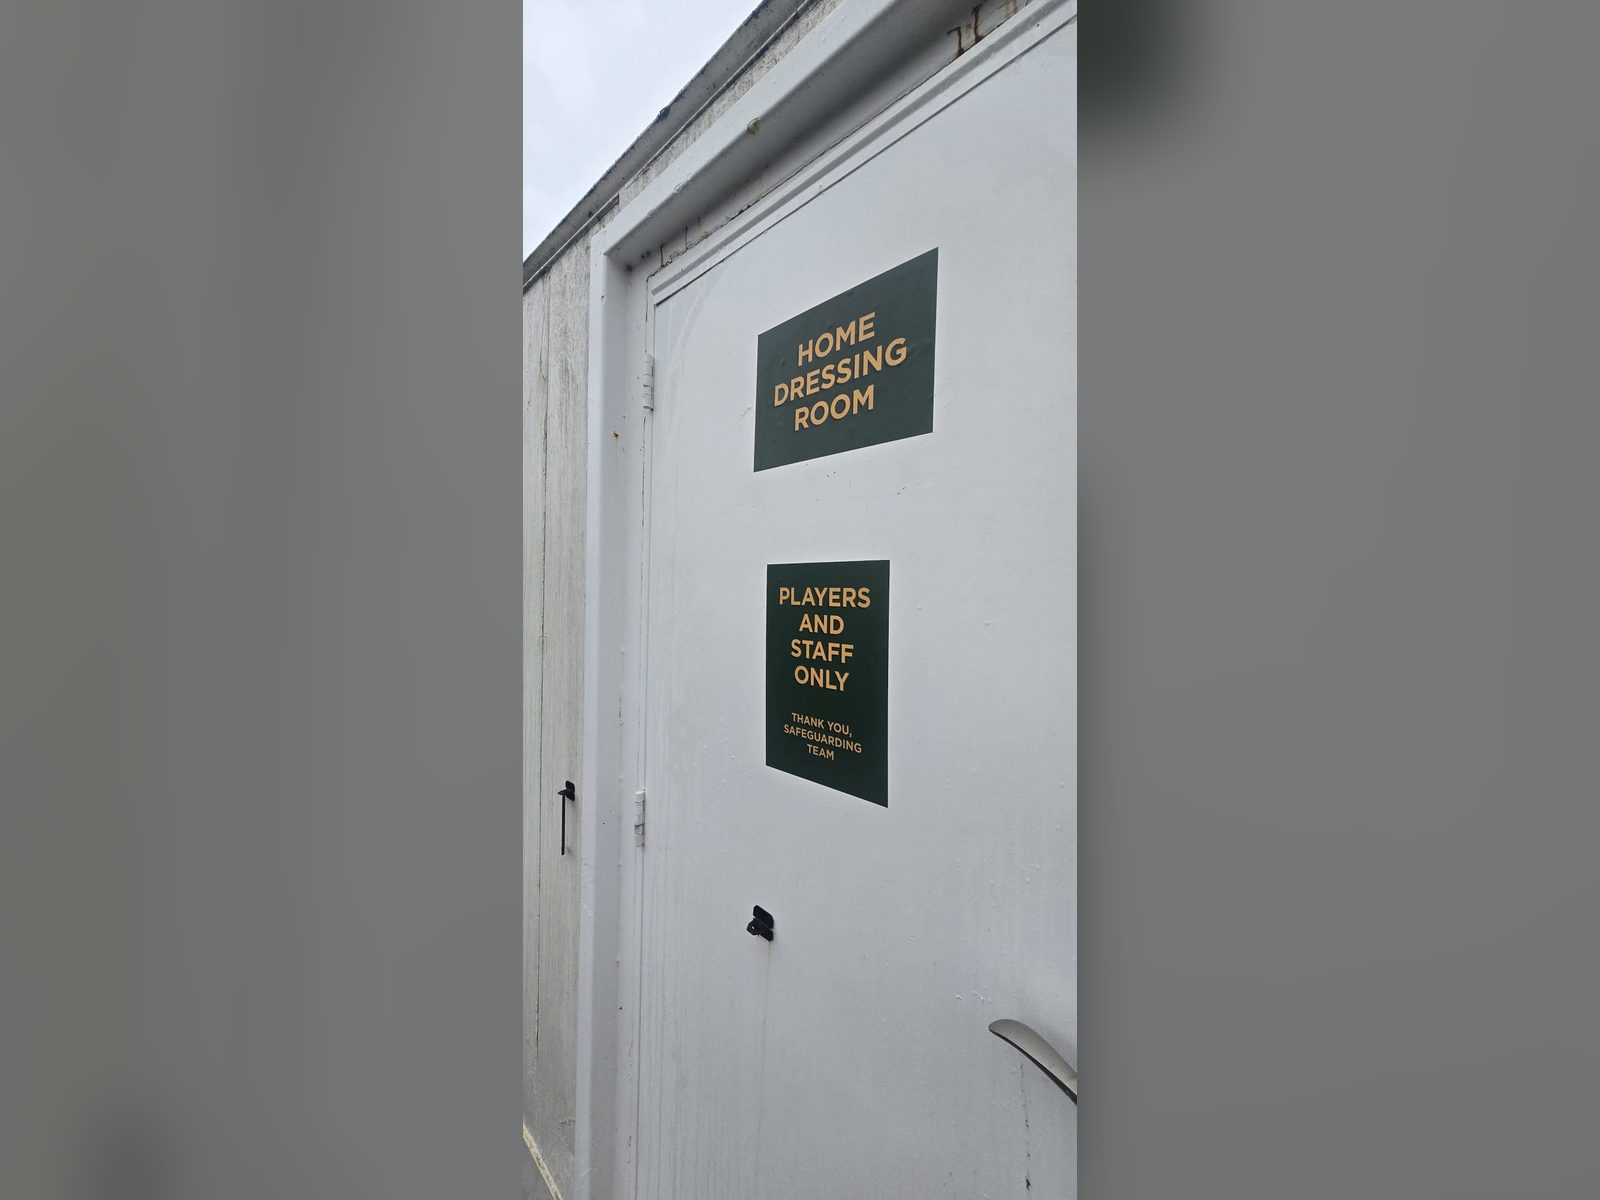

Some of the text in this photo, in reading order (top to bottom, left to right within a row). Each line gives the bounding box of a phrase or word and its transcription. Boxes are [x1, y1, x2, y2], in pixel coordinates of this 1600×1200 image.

[797, 311, 876, 367] HOME
[773, 337, 908, 407] DRESSING
[794, 384, 875, 432] ROOM
[779, 587, 871, 608] PLAYERS
[799, 613, 845, 635] AND
[790, 639, 854, 664] STAFF
[794, 665, 849, 692] ONLY
[791, 712, 853, 738] THANK YOU,
[783, 724, 862, 754] SAFEGUARDING
[806, 743, 835, 761] TEAM
